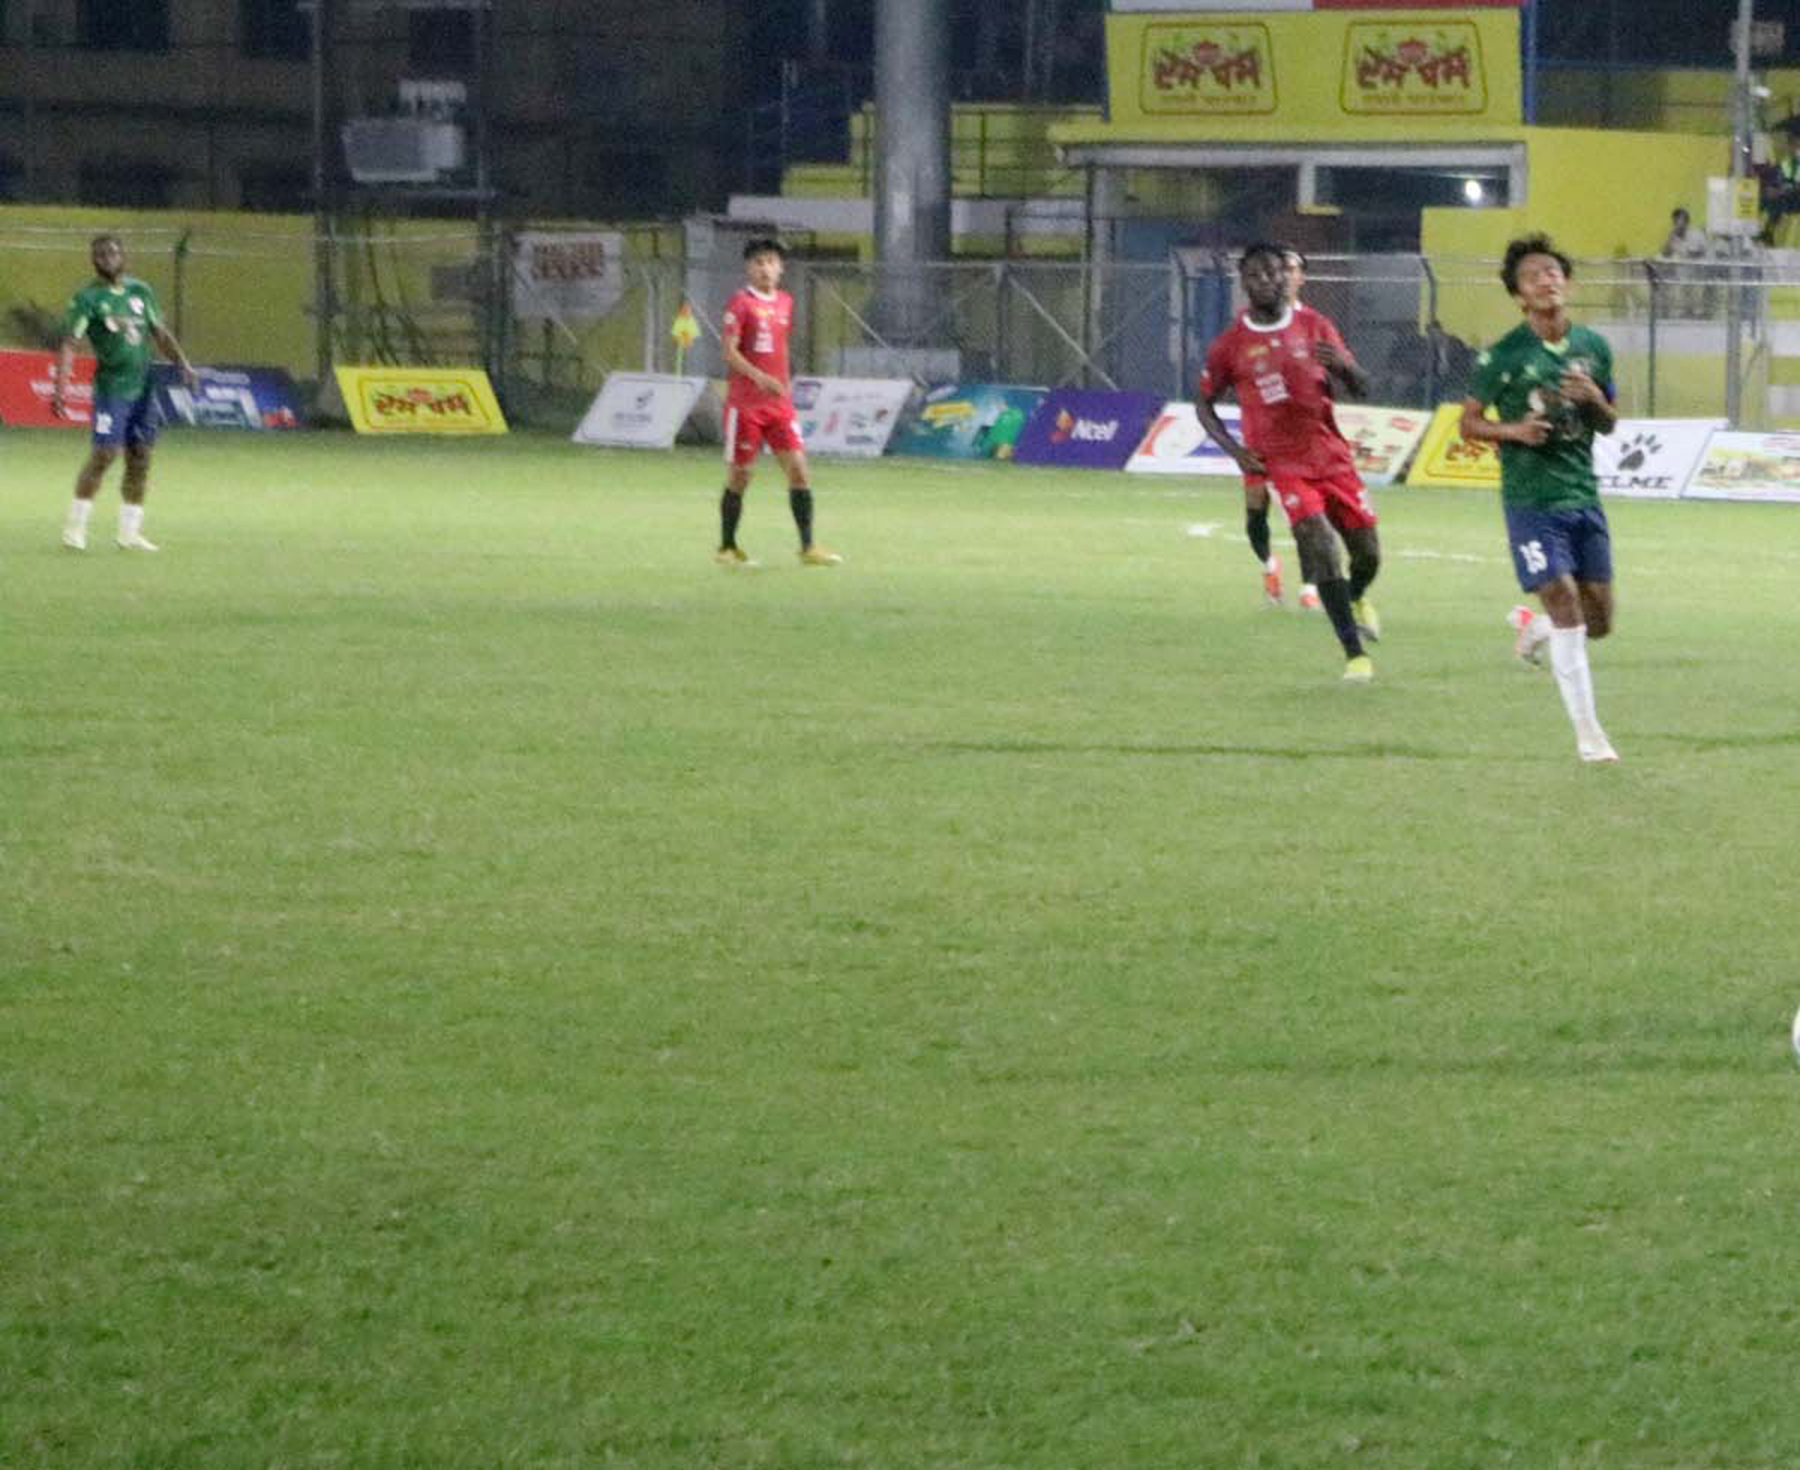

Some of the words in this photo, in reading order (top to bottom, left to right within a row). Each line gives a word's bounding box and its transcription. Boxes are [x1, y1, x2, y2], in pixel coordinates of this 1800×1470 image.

[1070, 418, 1119, 442] Ncell
[1593, 475, 1673, 490] ELME
[1519, 540, 1548, 574] 15
